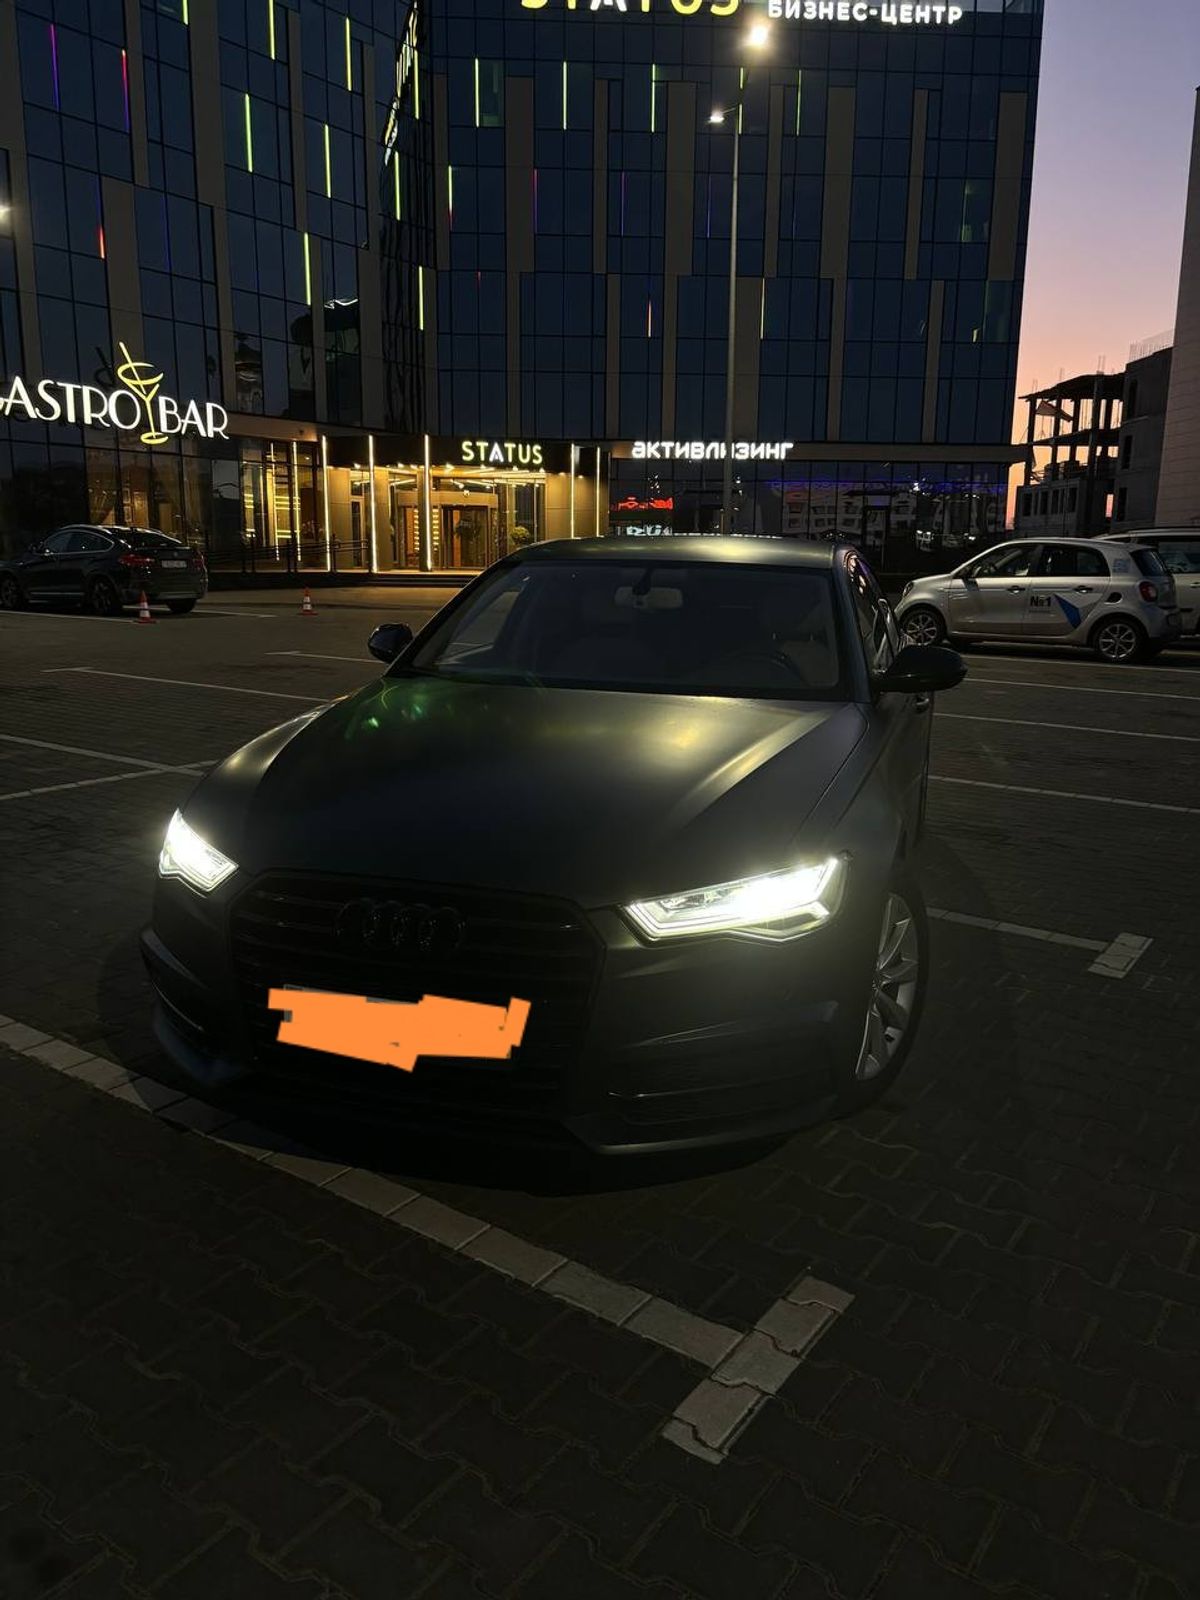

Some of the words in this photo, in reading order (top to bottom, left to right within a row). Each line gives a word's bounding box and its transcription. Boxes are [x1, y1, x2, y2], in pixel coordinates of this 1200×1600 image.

[768, 0, 963, 25] БИЗНЕС-ЦЕНТР
[0, 375, 141, 430] ASTRO
[158, 395, 230, 440] BAR
[461, 440, 543, 465] STATUS
